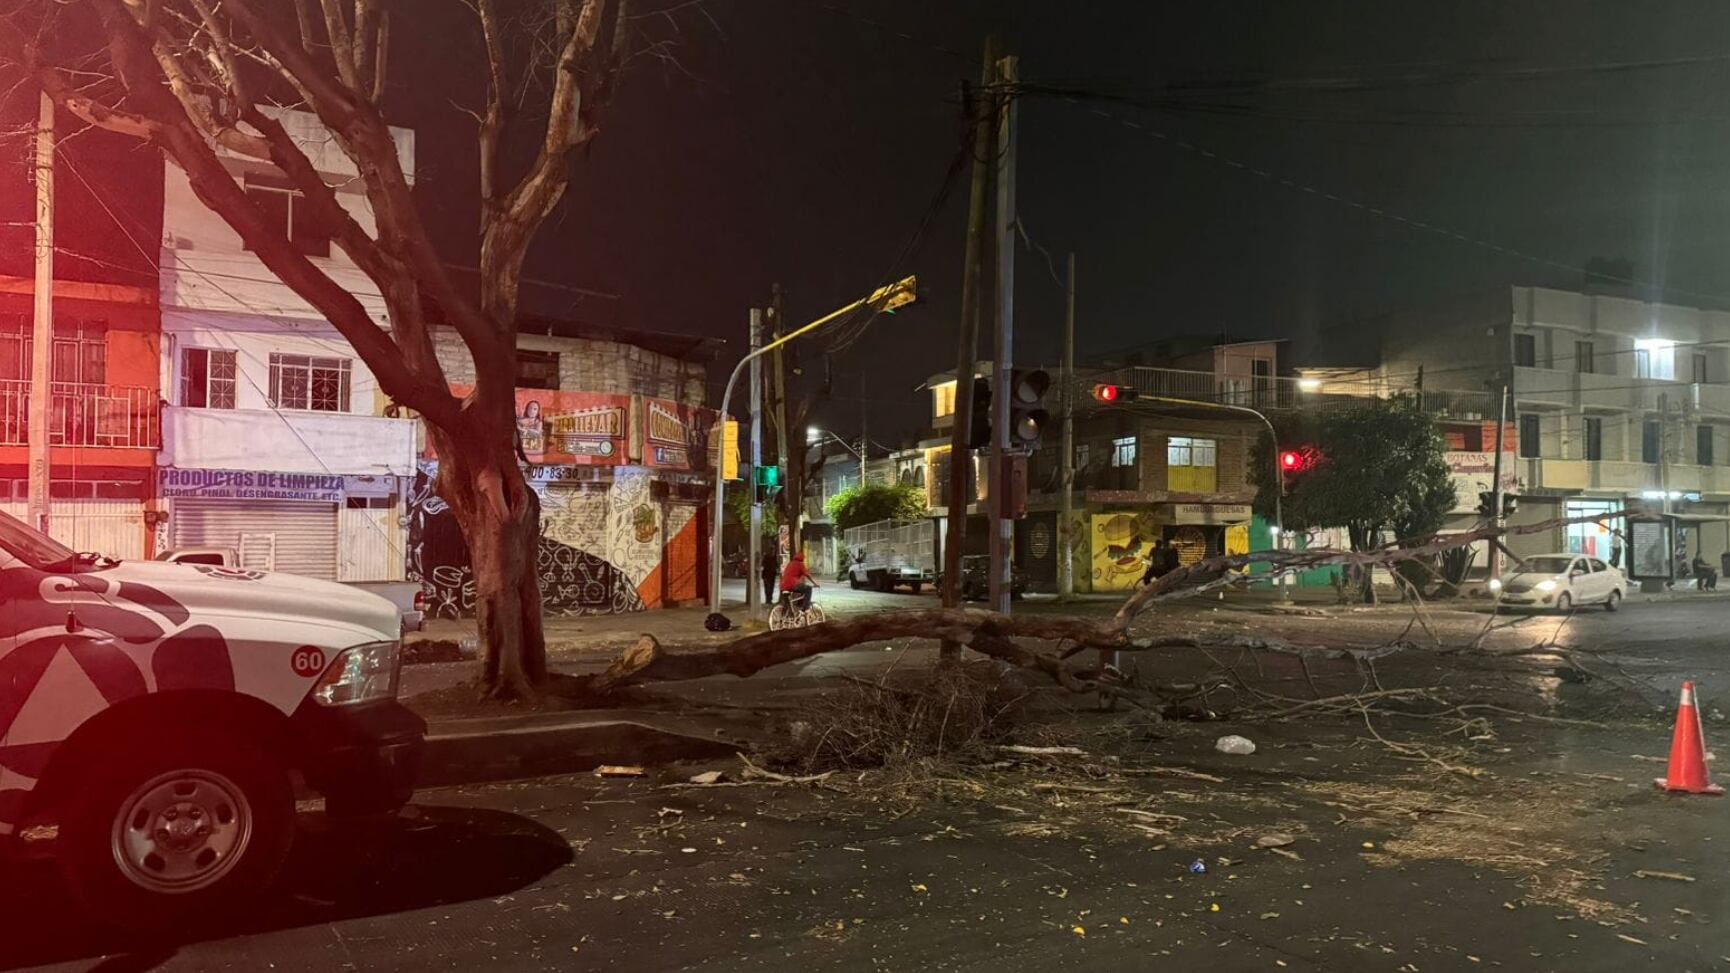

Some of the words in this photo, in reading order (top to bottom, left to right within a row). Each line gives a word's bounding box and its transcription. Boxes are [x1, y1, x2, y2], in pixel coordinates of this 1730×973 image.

[159, 469, 254, 487] PRODUCTOS
[257, 472, 276, 488] DE
[279, 474, 345, 490] LIMPIEZA
[295, 652, 322, 670] 60
